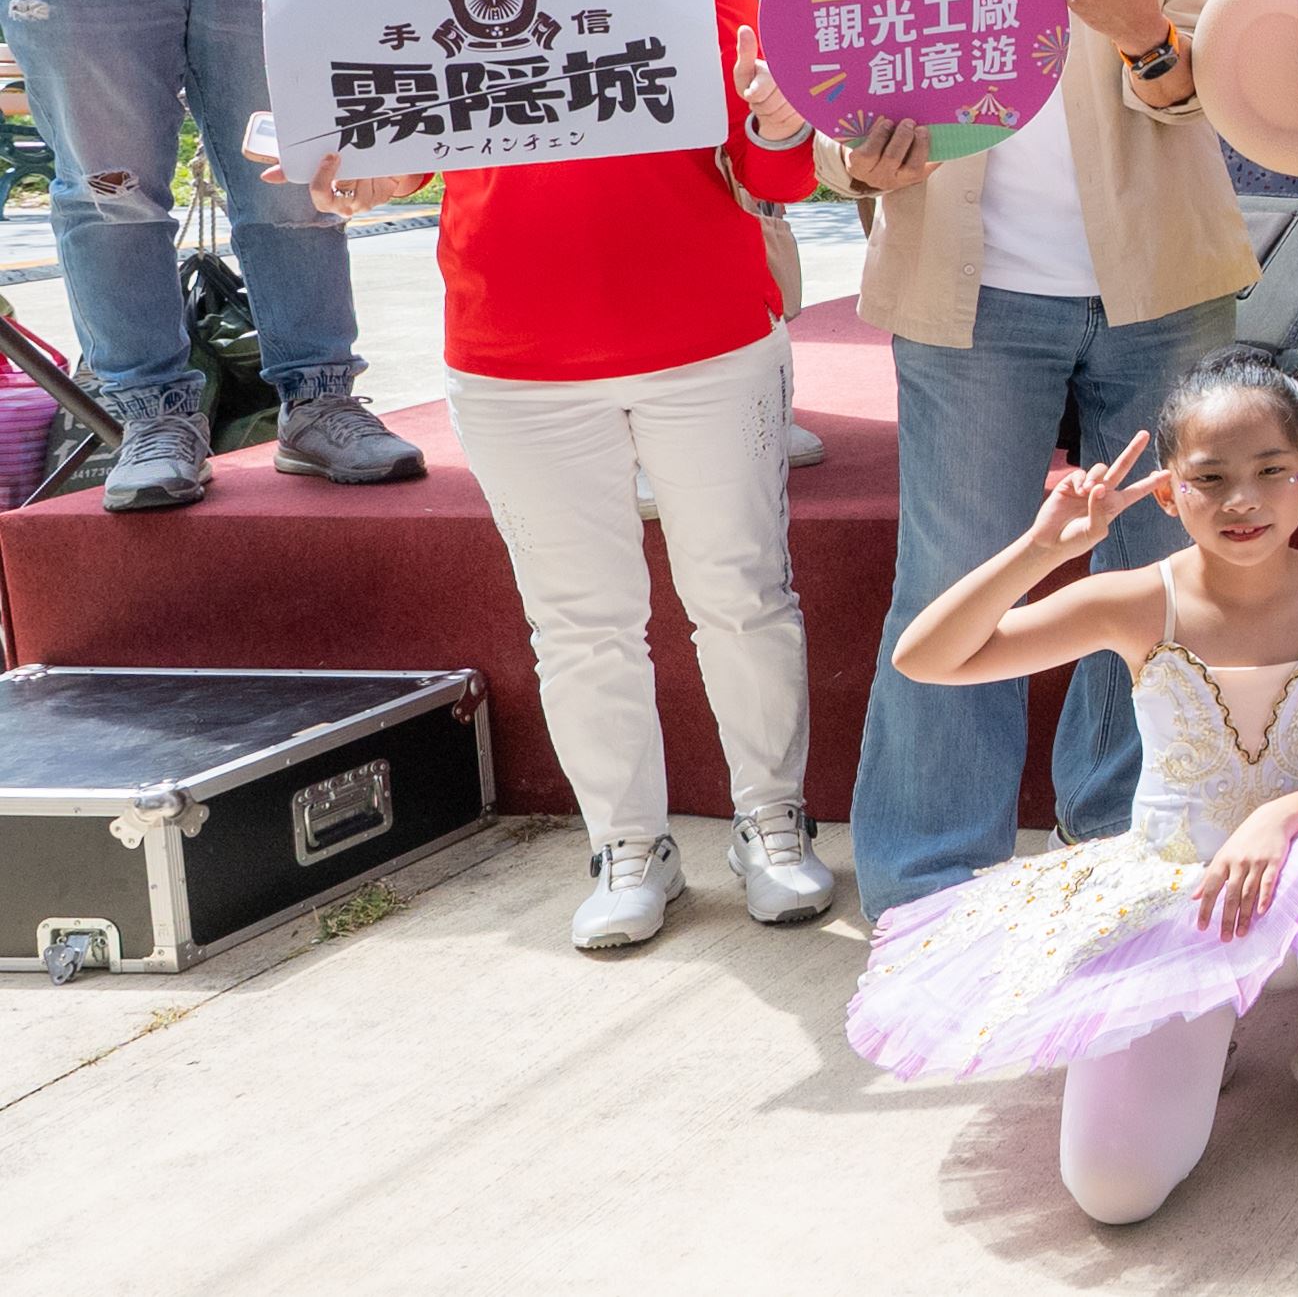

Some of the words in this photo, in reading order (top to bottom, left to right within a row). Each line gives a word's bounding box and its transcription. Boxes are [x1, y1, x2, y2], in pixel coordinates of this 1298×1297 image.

[378, 22, 422, 51] 手
[570, 9, 613, 35] 信
[867, 35, 1019, 96] 創意遊
[432, 131, 586, 160] ウーインチェン
